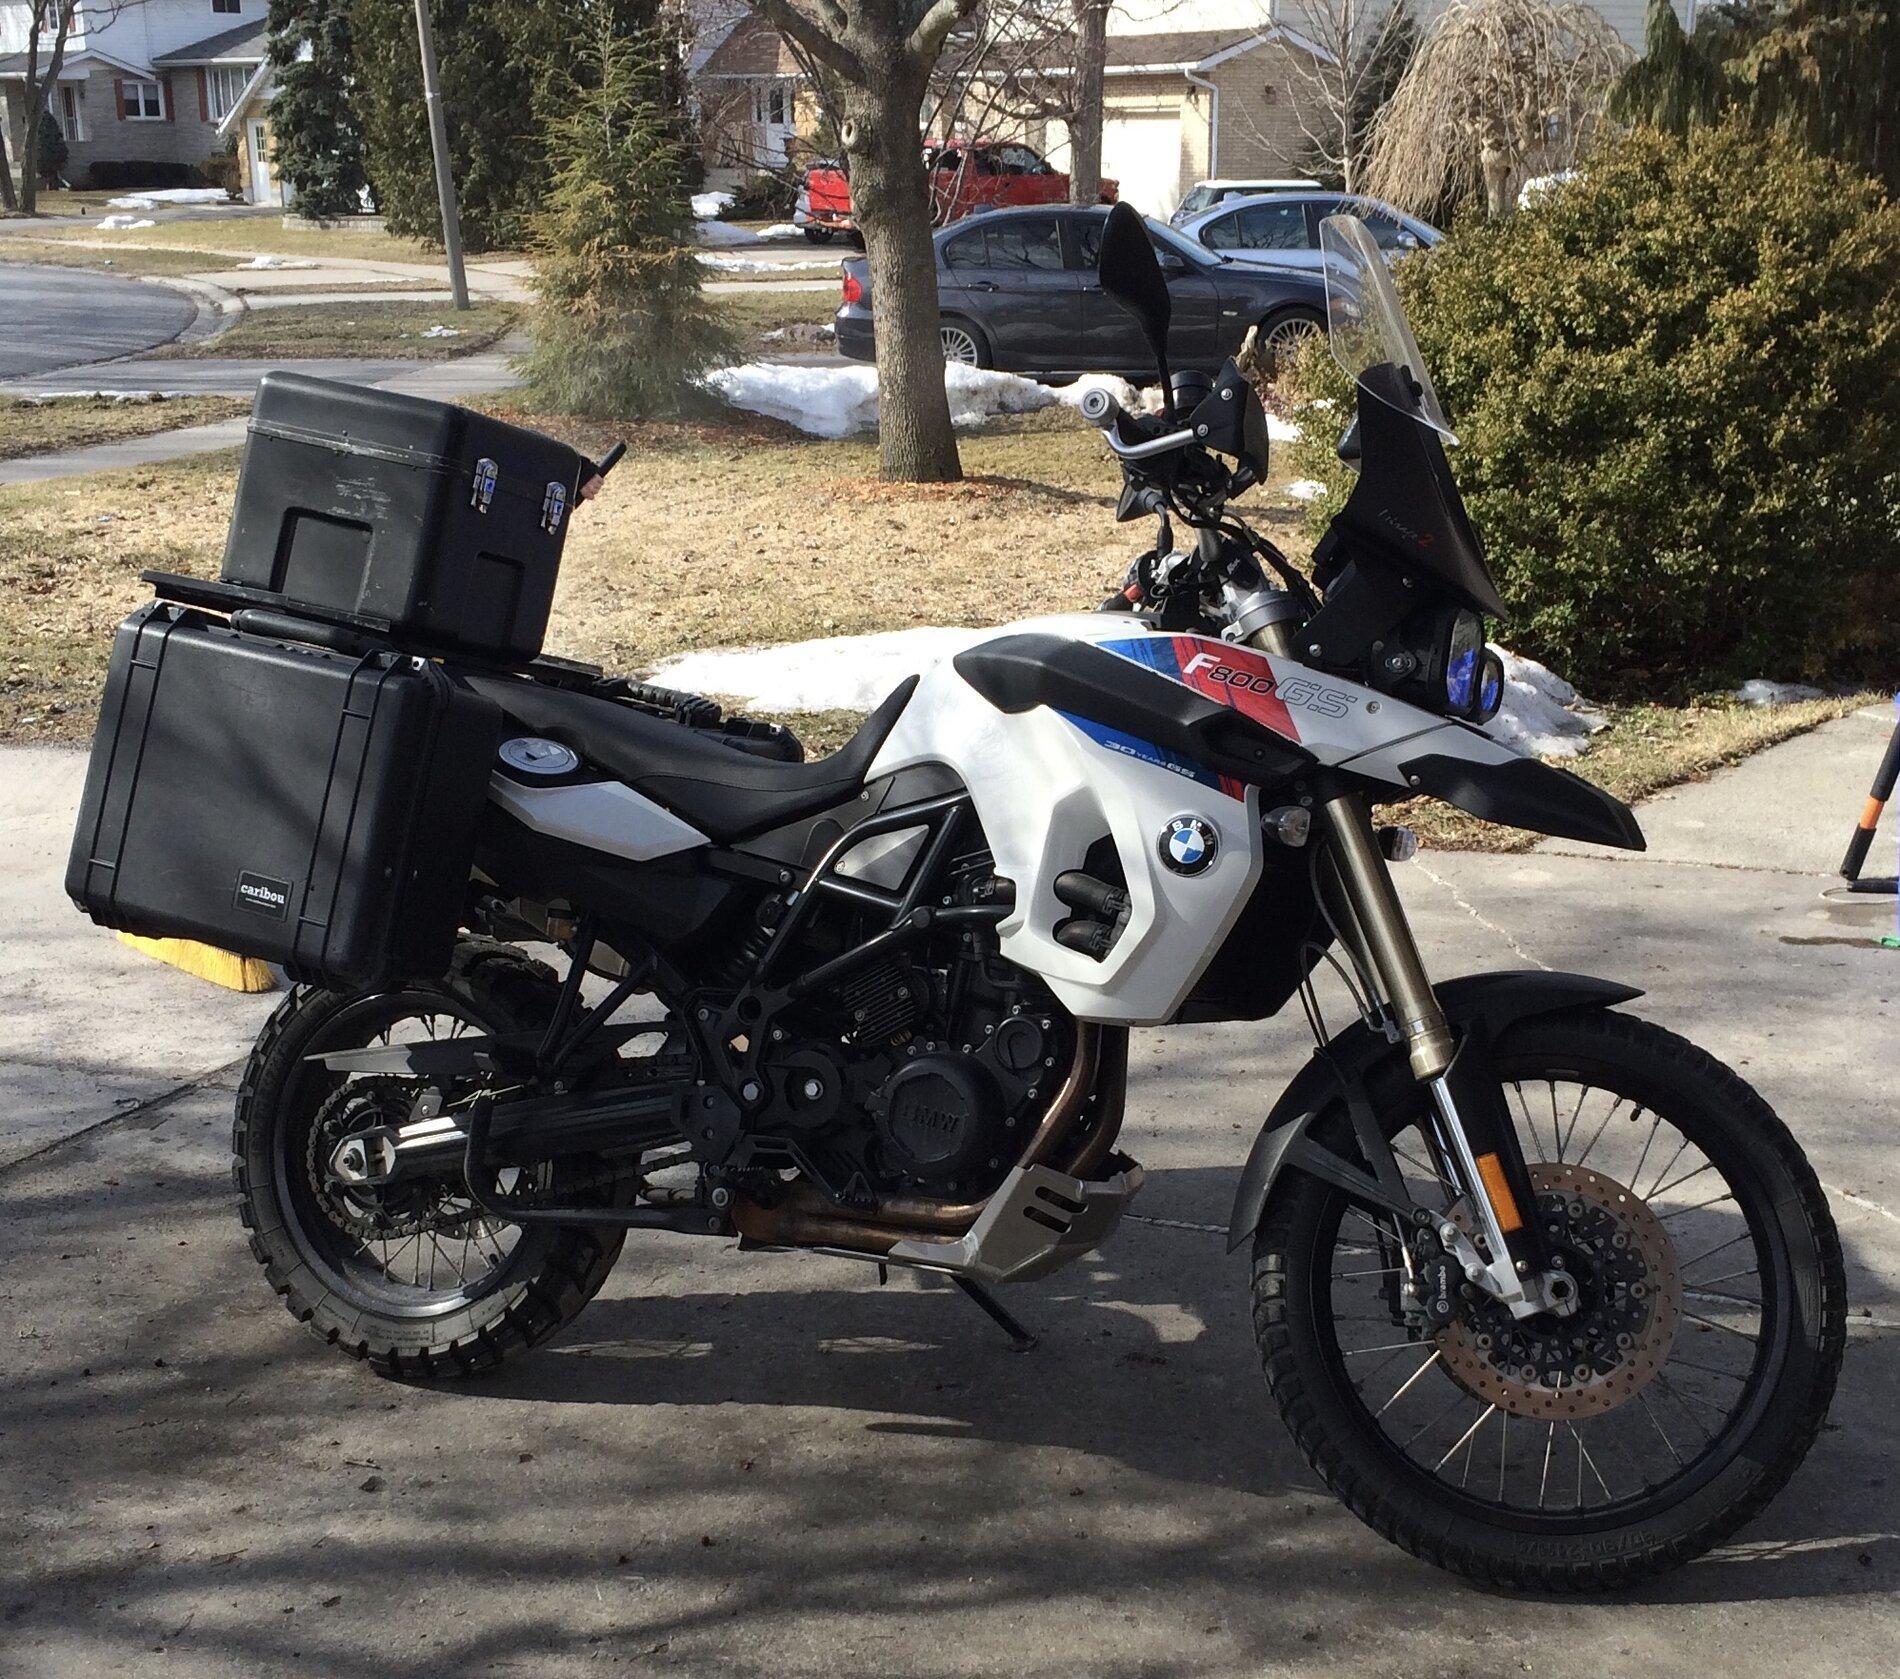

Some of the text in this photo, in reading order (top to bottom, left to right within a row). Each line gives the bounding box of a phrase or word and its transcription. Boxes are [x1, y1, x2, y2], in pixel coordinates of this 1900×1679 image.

[1166, 761, 1196, 779] GS
[240, 884, 285, 905] caribou
[1437, 1265, 1447, 1299] brembo
